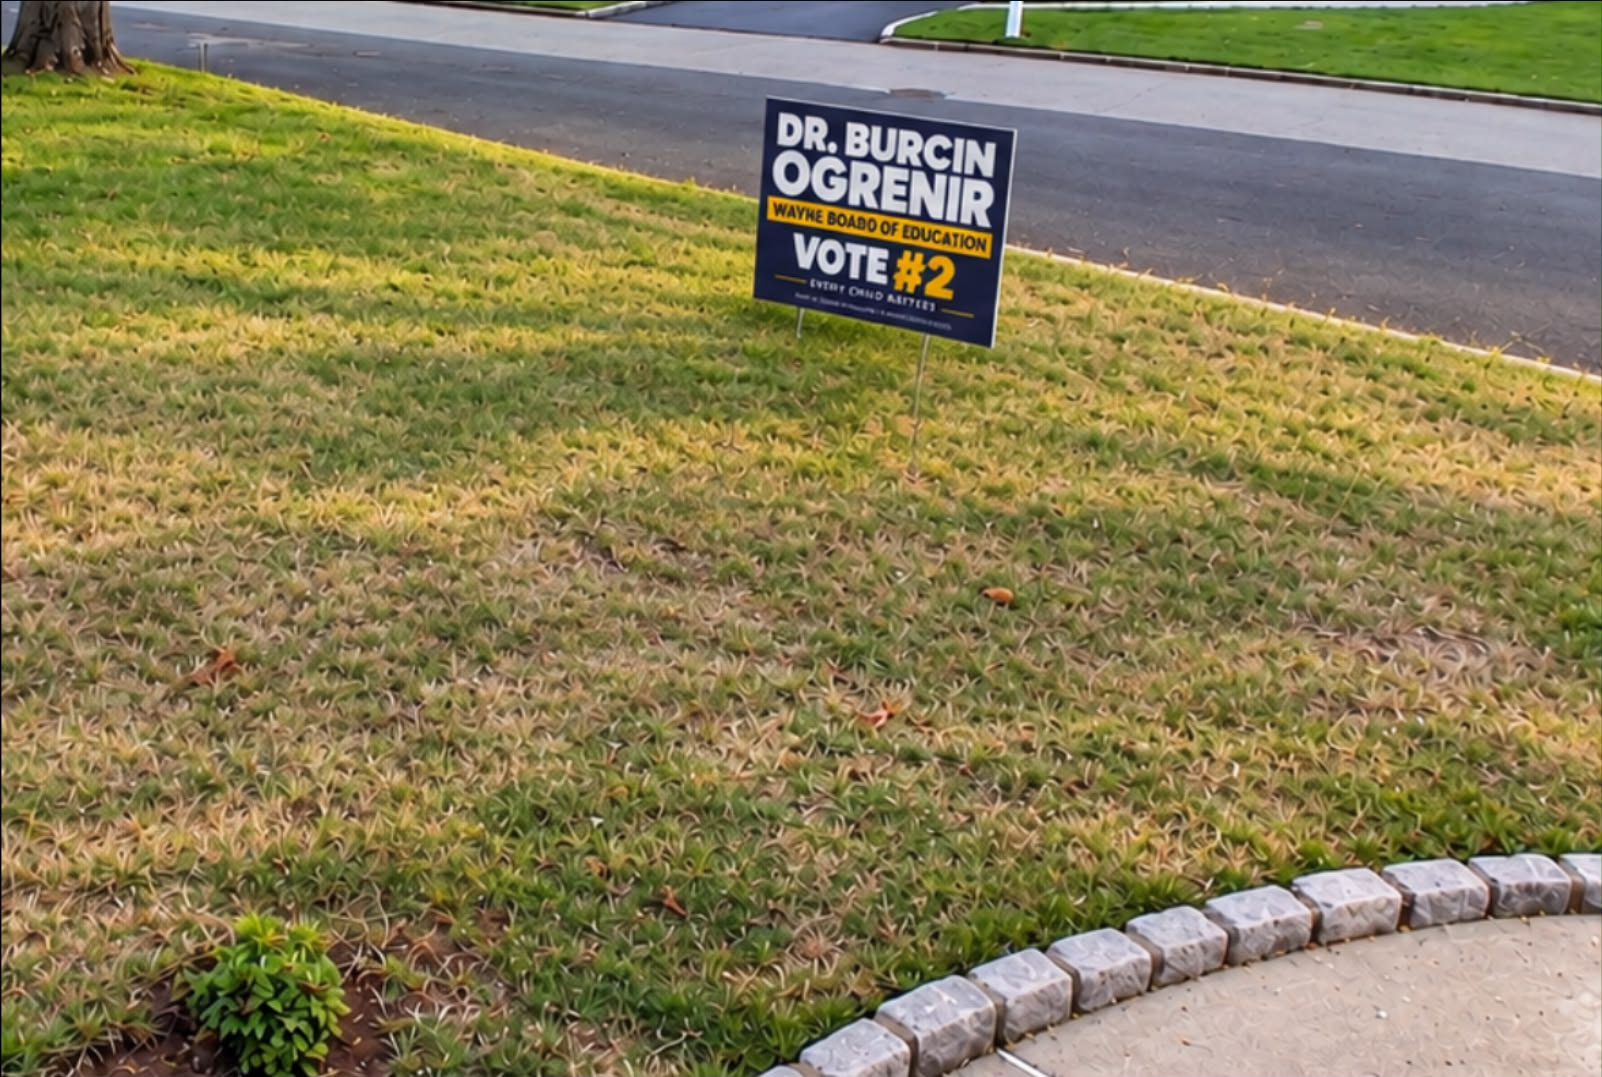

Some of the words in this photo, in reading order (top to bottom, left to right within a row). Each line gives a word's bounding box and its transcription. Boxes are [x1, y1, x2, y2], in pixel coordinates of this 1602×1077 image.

[777, 112, 838, 154] DR.
[845, 121, 996, 178] BURCIN
[772, 150, 995, 228] OGRENIR
[773, 202, 823, 224] WAYNE
[880, 220, 899, 237] OF
[902, 224, 987, 252] EDUCATION
[793, 232, 889, 285] VOTE
[893, 249, 956, 300] #2
